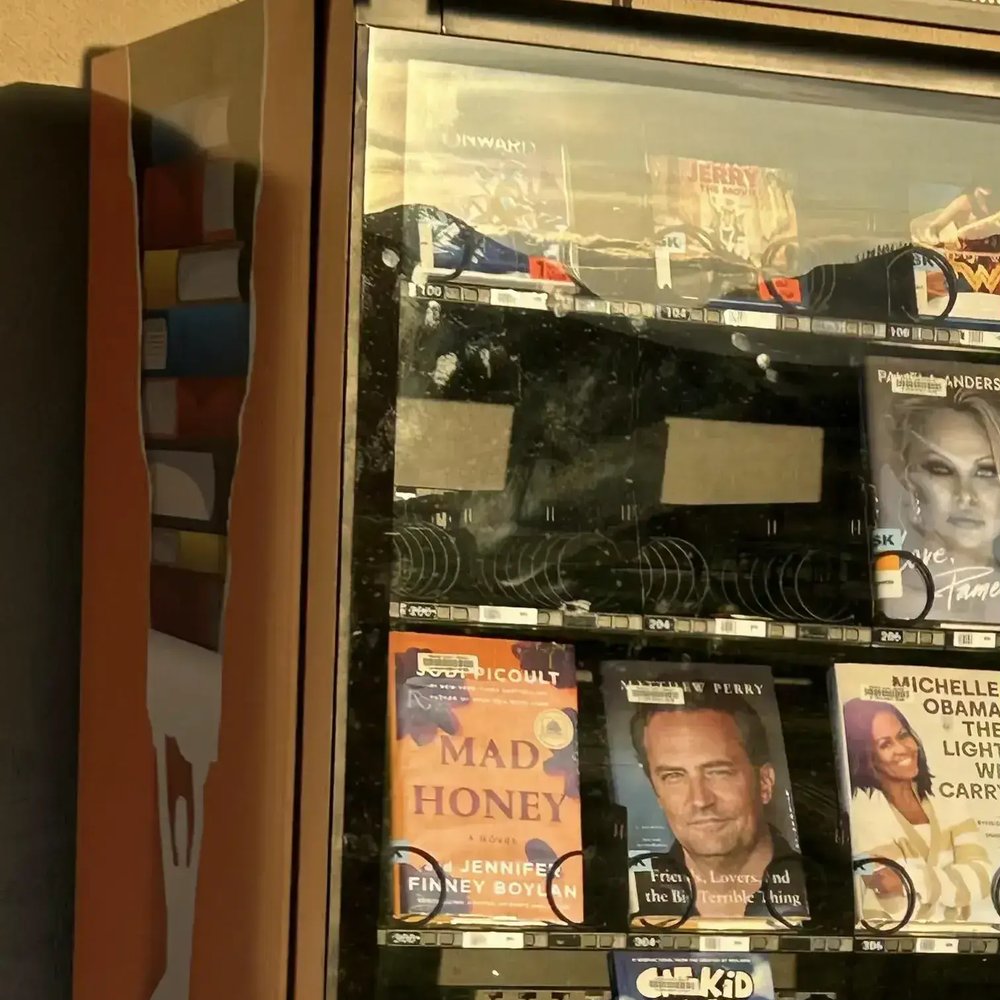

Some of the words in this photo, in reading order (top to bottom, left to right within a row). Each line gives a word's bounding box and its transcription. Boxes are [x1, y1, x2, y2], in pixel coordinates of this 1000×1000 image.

[689, 161, 760, 185] JERRY
[474, 668, 560, 686] PICOULT
[892, 675, 999, 698] MICHELLE
[713, 683, 764, 696] PERRY
[440, 735, 540, 770] MAD
[413, 785, 567, 823] HONEY
[460, 860, 562, 878] JENNIFER
[408, 876, 486, 895] FINNEY
[493, 881, 578, 899] BOYLAN
[645, 888, 669, 903] the
